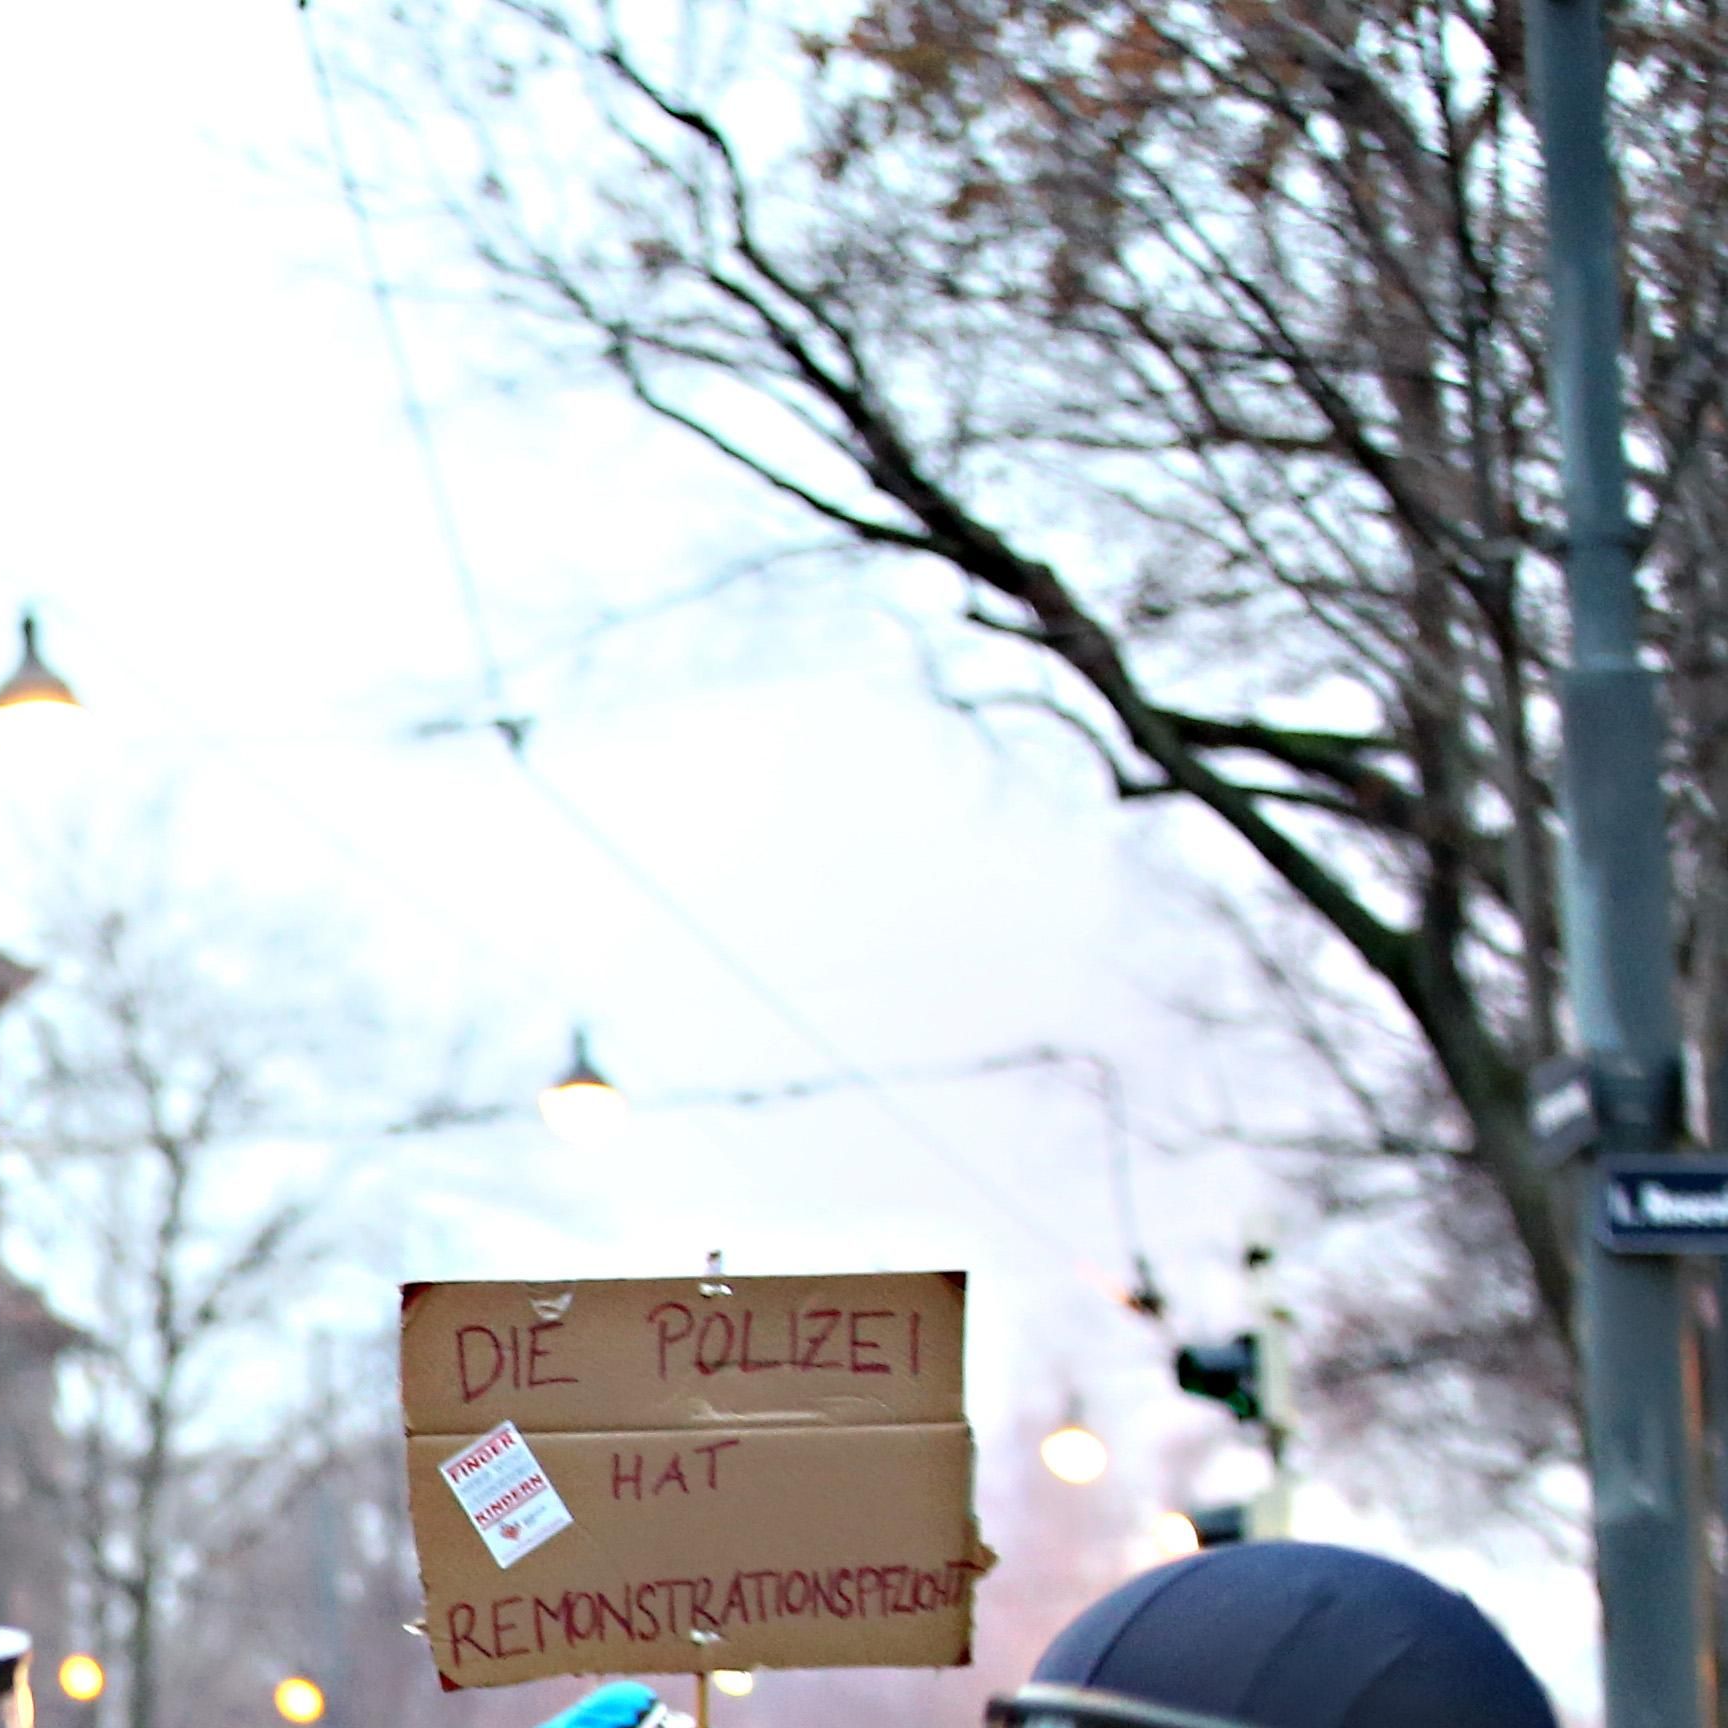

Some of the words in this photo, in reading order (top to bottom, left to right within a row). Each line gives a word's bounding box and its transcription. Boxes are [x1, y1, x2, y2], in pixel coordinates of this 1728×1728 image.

[456, 1320, 578, 1403] DIE
[648, 1302, 921, 1381] POLIZEI
[611, 1439, 741, 1501] HAT
